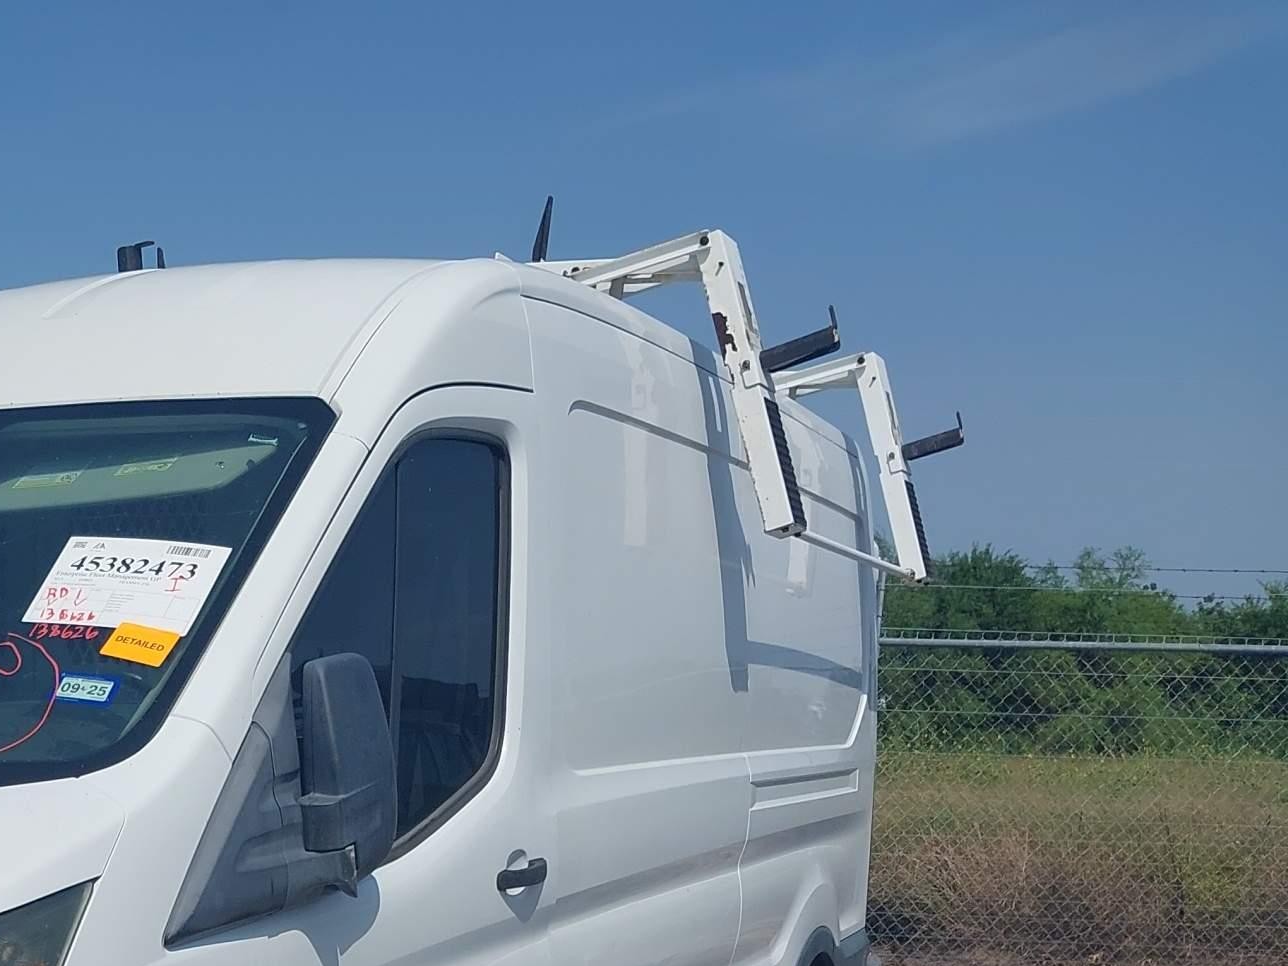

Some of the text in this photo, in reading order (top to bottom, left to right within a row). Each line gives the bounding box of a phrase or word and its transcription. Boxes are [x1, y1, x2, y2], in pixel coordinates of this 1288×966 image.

[70, 555, 199, 582] 45382473
[114, 634, 166, 652] DETAILED
[60, 682, 109, 697] 09 25
